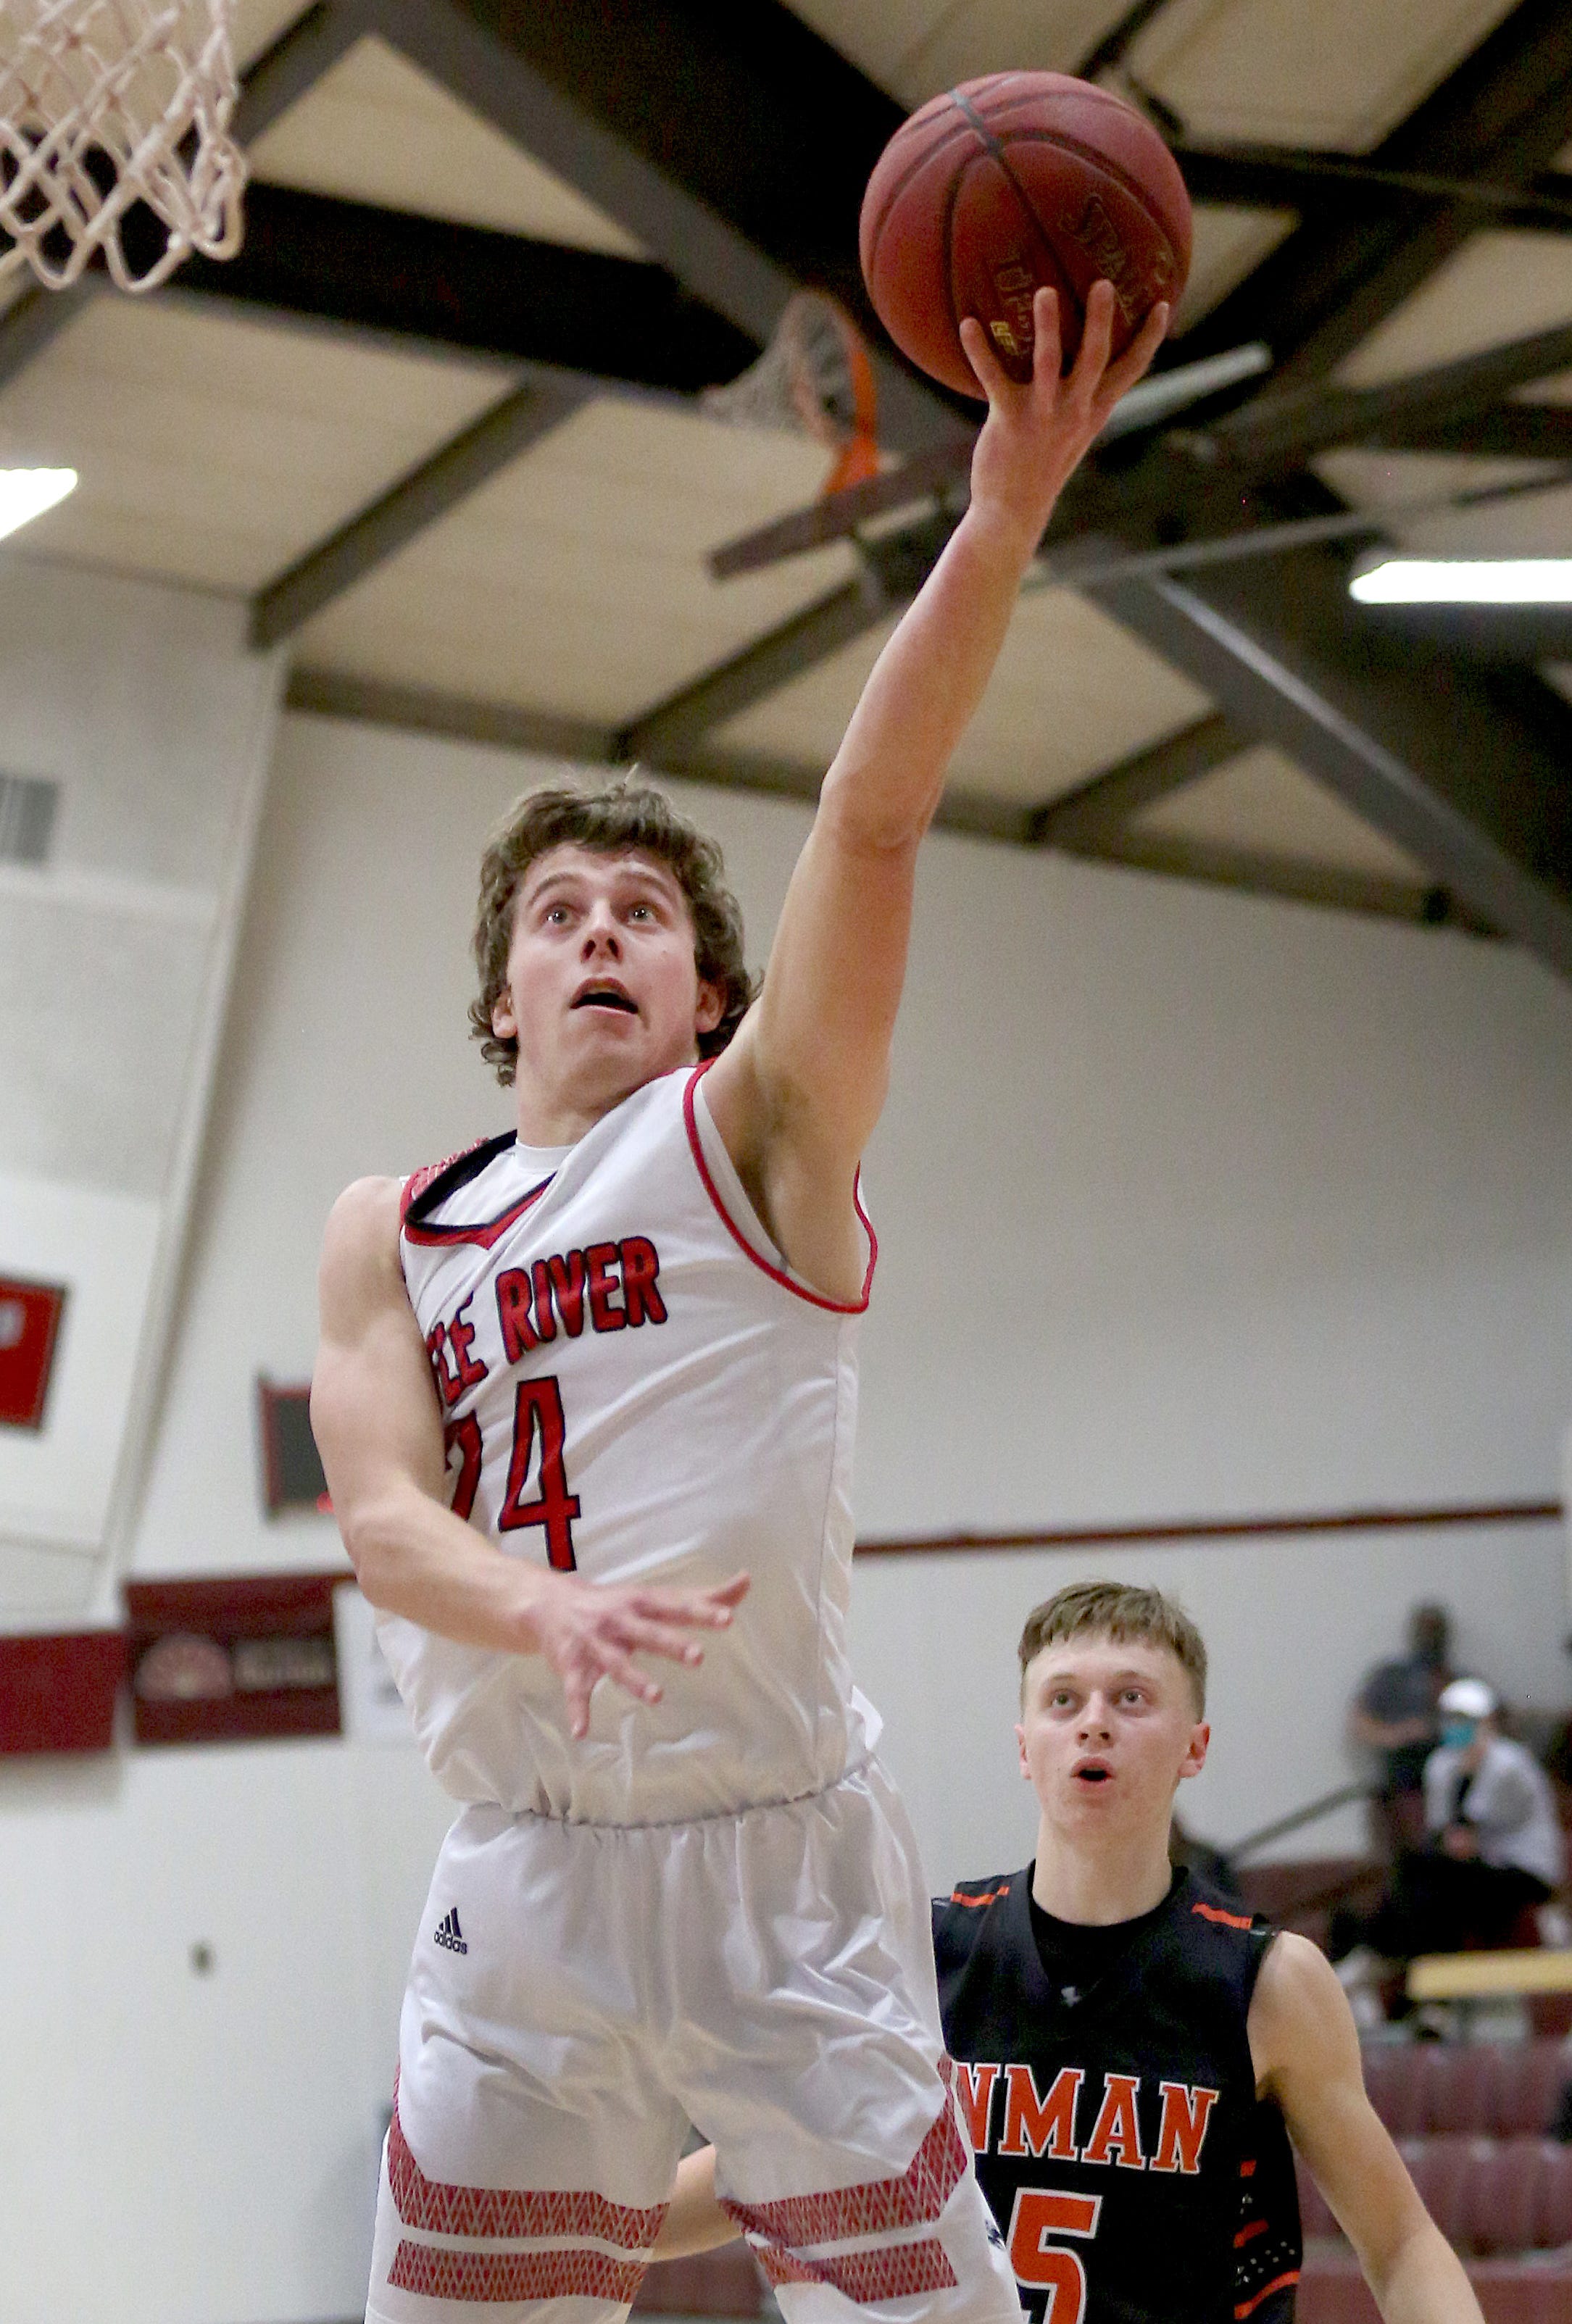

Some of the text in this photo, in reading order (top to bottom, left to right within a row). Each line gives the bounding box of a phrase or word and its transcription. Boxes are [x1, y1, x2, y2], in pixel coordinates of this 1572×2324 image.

[427, 1236, 668, 1406] LE RIVER
[434, 1931, 467, 1954] adidas
[1006, 2187, 1102, 2324] 5
